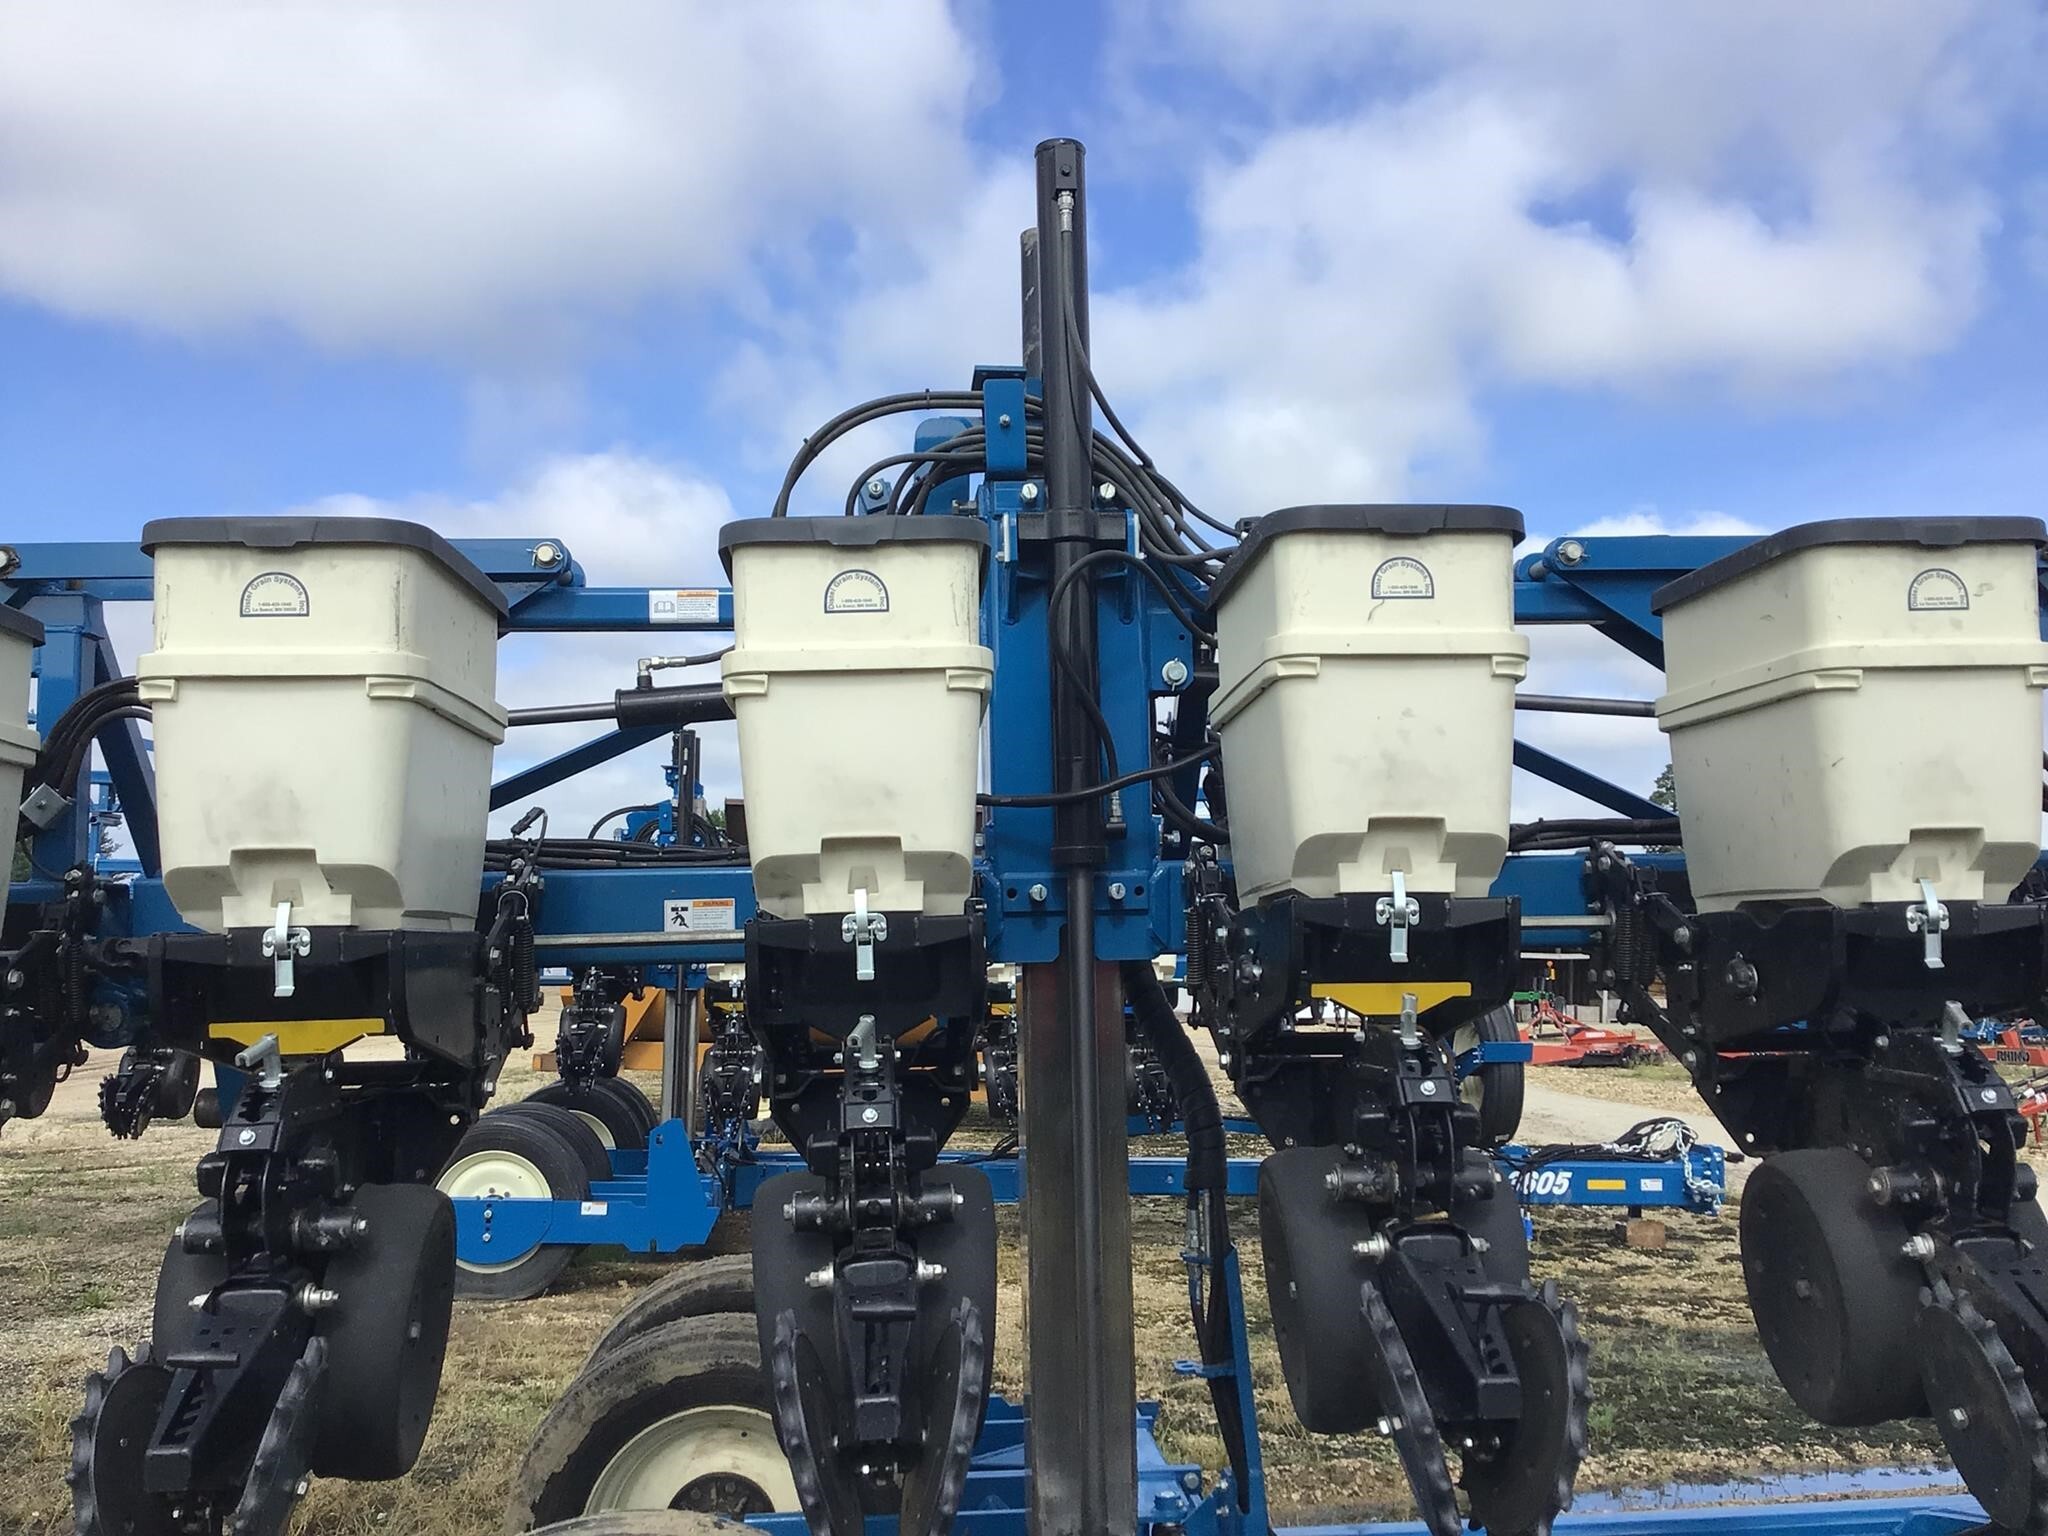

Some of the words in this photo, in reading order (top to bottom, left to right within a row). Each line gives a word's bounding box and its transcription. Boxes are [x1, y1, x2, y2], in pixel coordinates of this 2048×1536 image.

[1380, 561, 1399, 574] Grain
[250, 576, 272, 591] Grain
[834, 574, 853, 588] Grain
[1996, 1050, 2030, 1063] RHINO
